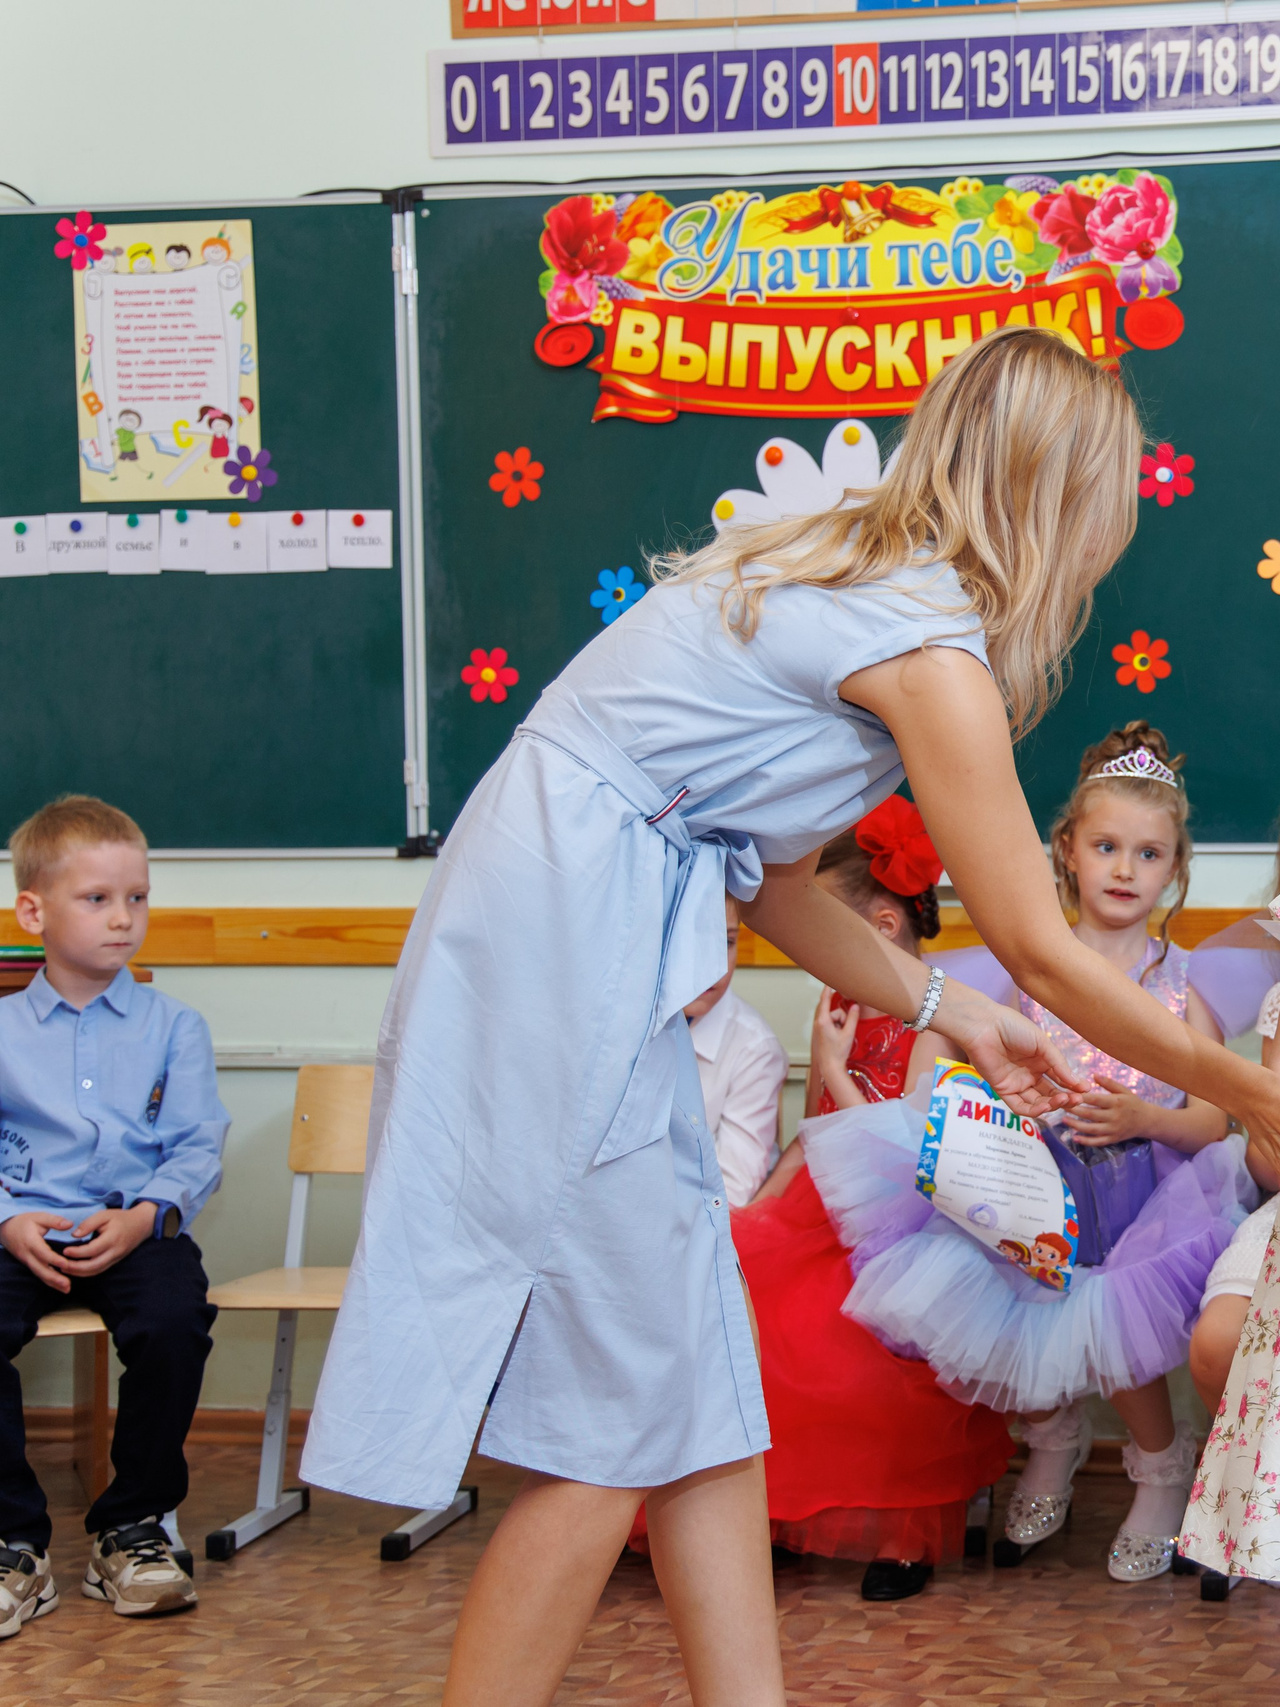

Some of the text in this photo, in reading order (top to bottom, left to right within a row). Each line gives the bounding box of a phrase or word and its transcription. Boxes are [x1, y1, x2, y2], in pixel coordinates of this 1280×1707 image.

[451, 75, 477, 133] 0
[492, 74, 510, 130] 1
[529, 72, 555, 129] 2
[568, 70, 593, 128] 3
[605, 69, 633, 125] 4
[645, 67, 670, 124] 5
[682, 64, 709, 122] 6
[722, 63, 748, 120] 7
[762, 60, 789, 119] 8
[800, 58, 828, 117] 9
[837, 56, 876, 114] 10
[883, 54, 917, 112] 11
[925, 52, 964, 110] 12
[971, 50, 1010, 108] 13
[1015, 48, 1055, 105] 14
[1061, 45, 1100, 103] 15
[1106, 42, 1146, 101] 16
[1151, 40, 1191, 98] 17
[1197, 37, 1238, 96] 18
[658, 194, 1025, 304] Удачи тебе,
